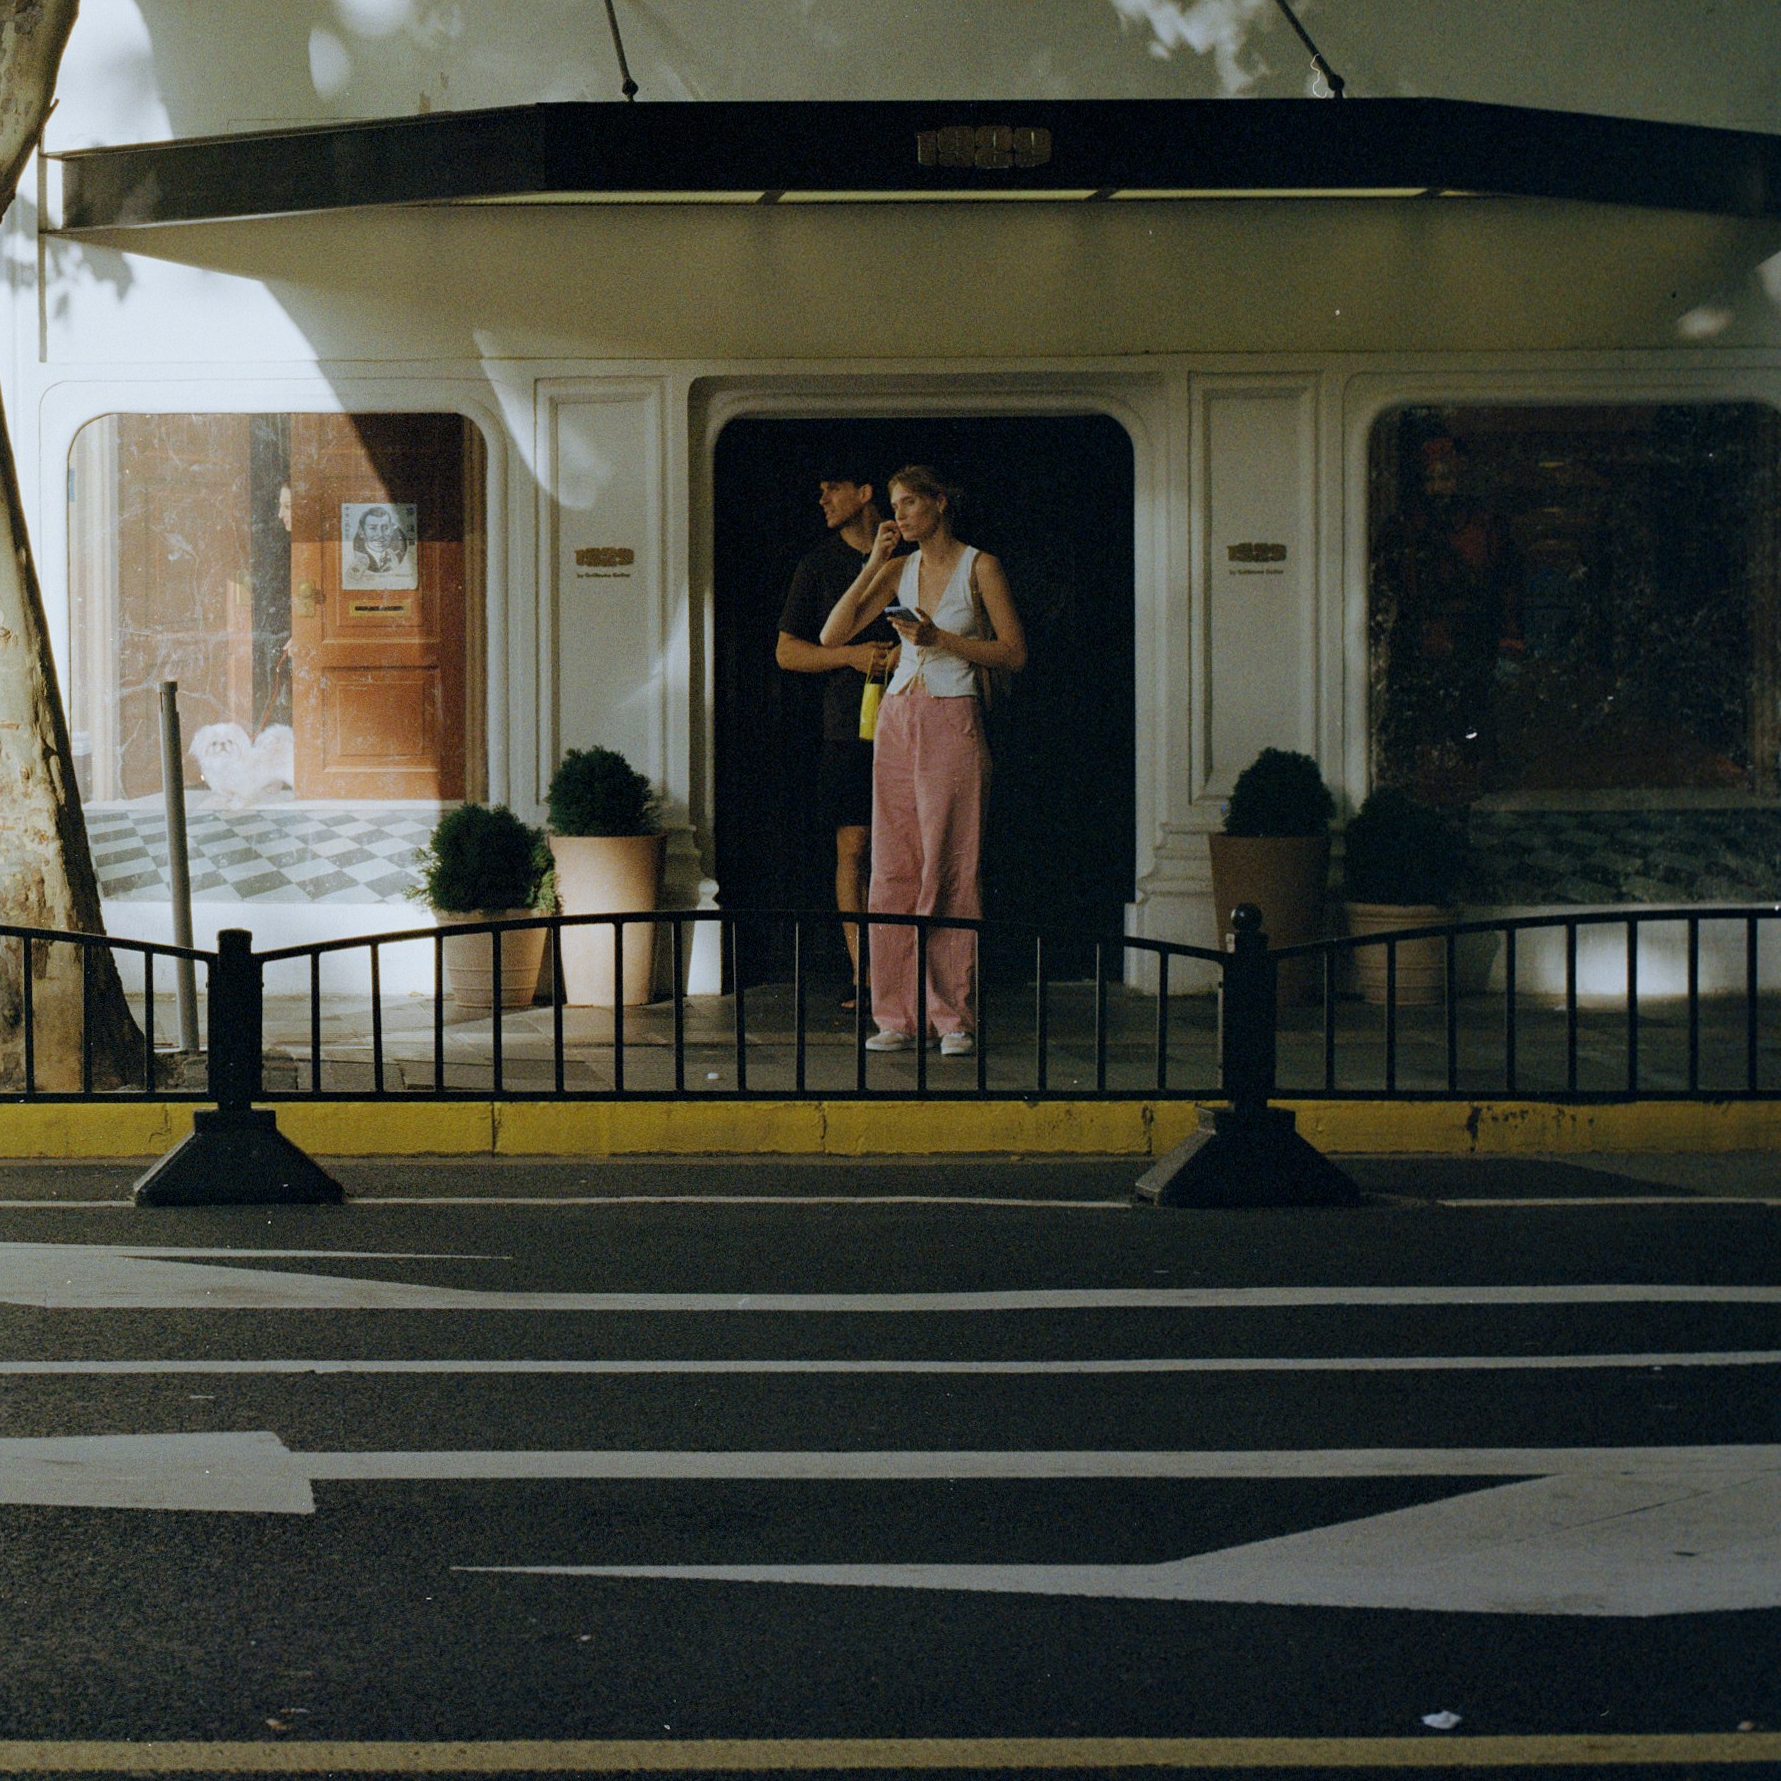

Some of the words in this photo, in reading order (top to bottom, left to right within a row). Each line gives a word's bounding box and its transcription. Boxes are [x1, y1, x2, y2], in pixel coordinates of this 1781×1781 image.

[916, 125, 1052, 169] 1929
[574, 547, 635, 567] 1929
[1226, 542, 1287, 563] 1929
